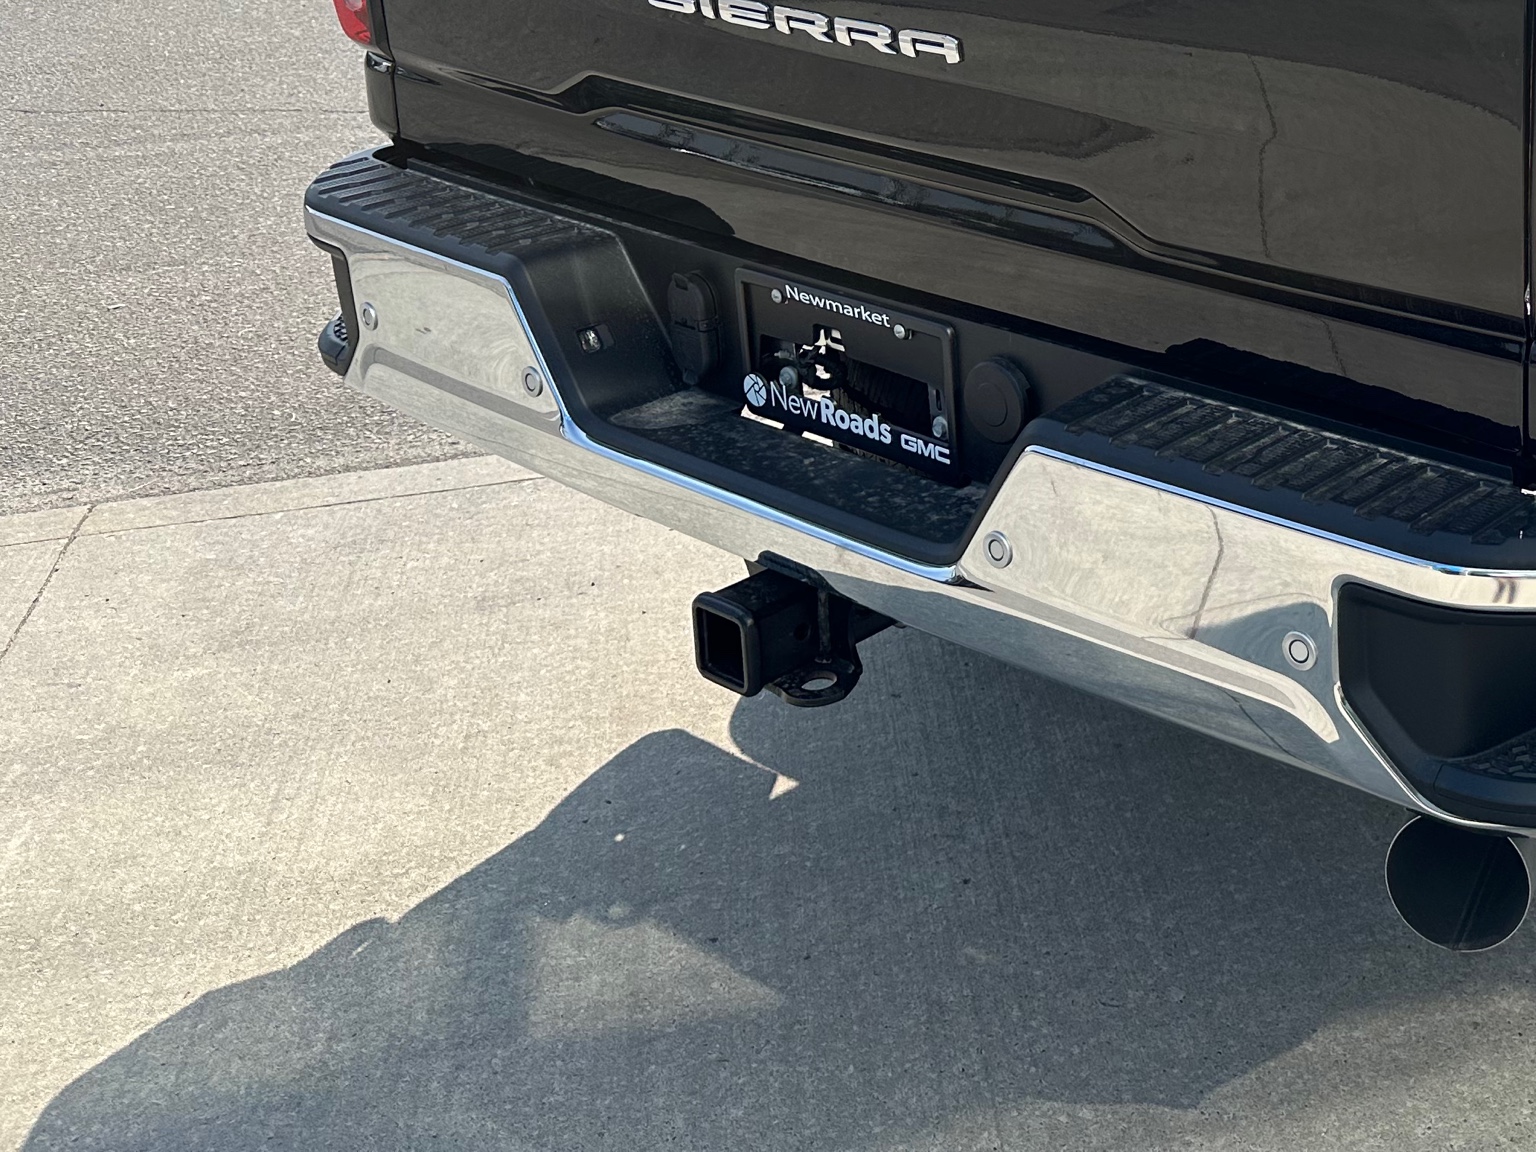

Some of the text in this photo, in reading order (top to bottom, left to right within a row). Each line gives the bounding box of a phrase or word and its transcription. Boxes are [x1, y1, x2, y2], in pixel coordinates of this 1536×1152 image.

[785, 284, 891, 328] Newmarket
[770, 381, 951, 465] NewRoads GMC
